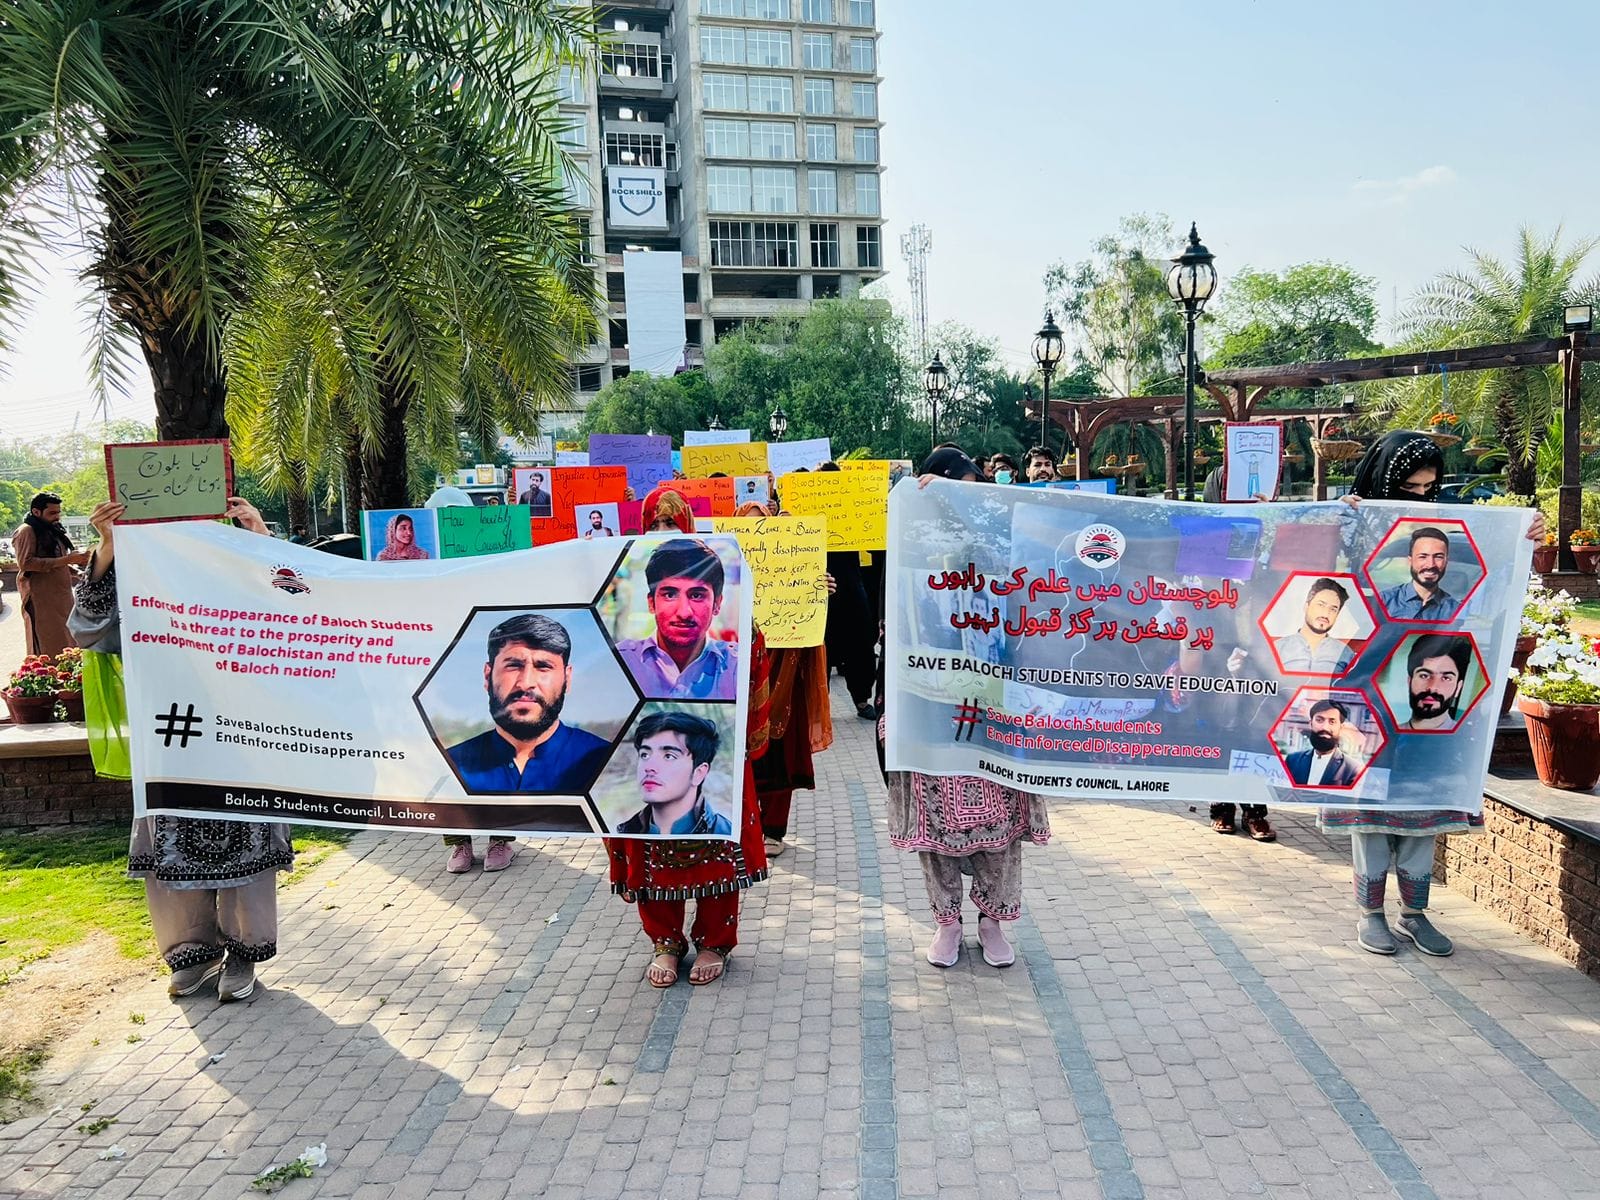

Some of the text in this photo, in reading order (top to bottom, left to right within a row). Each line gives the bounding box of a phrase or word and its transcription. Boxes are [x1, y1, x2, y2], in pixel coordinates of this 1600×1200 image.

[138, 451, 181, 478] بلوچ
[927, 562, 1239, 610] بلوچستان میں علم کی راہوں
[131, 595, 433, 632] Enforced disappearance of Baloch Students
[949, 606, 1000, 635] نہیں
[1005, 605, 1062, 637] قبول
[170, 617, 394, 648] is a threat to the prosperity and
[1121, 616, 1189, 643] قدغن
[1188, 626, 1214, 651] پر
[131, 630, 432, 666] development of Balochistan and the future
[215, 660, 337, 679] of Baloch nation!
[907, 654, 1278, 695] SAVE BALOCH STUDENTS TO SAVE EDUCATION
[215, 714, 354, 741] SaveBalochStudents
[986, 706, 1163, 736] SaveBalochStudents
[215, 731, 406, 761] EndEnforcedDisapperances
[986, 726, 1222, 760] EndEnforcedDisapperances
[978, 758, 1170, 793] BALOCH STUDENTS COUNCIL, LAHORE
[224, 792, 437, 822] Baloch Students Council, Lahore
